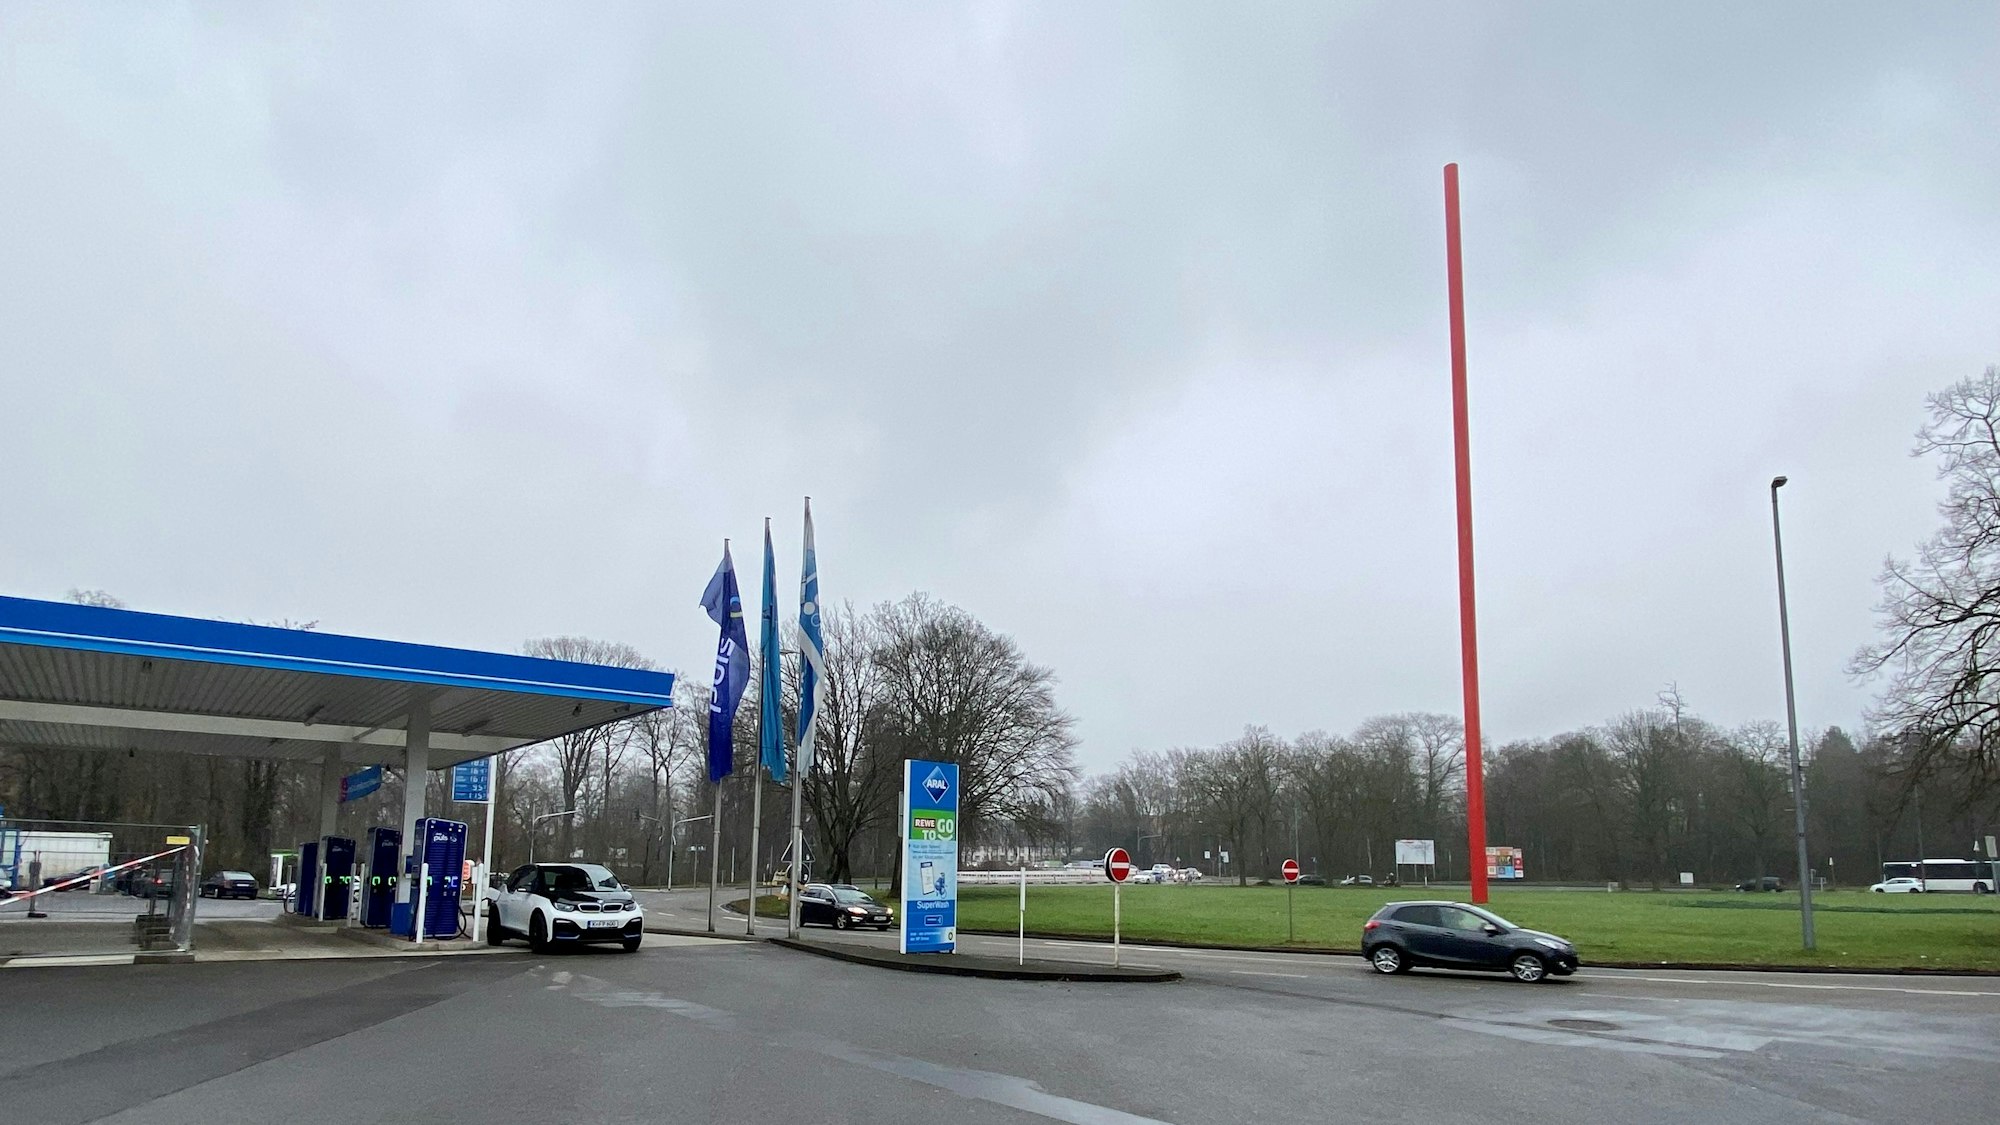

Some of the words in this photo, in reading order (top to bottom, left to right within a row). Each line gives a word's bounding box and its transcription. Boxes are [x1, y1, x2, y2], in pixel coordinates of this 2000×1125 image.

[926, 779, 946, 790] ARAL
[915, 819, 935, 828] REWE
[922, 830, 936, 840] TO
[937, 819, 954, 833] GO
[916, 901, 950, 910] SuperWash
